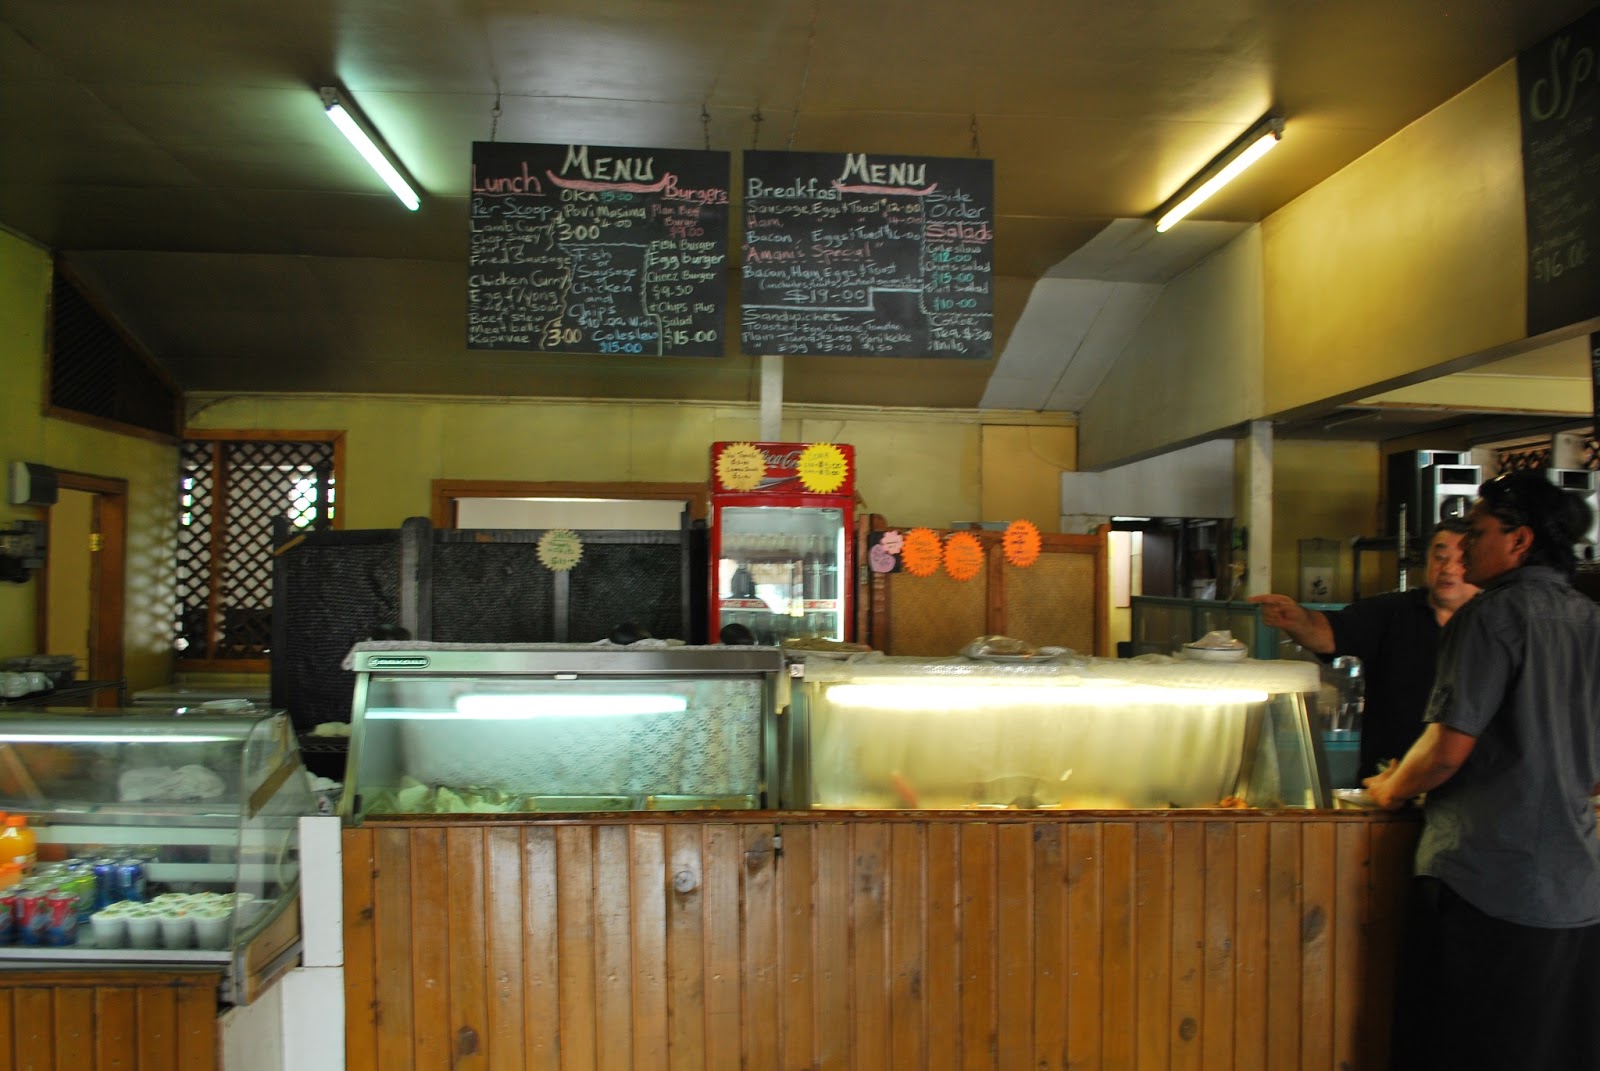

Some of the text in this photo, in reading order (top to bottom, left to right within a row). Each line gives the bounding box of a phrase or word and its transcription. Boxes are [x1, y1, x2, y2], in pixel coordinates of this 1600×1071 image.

[560, 144, 654, 181] MENU
[839, 153, 926, 188] MENU
[472, 161, 542, 193] Lunch
[560, 188, 599, 202] OKA
[664, 175, 728, 206] Burgers
[746, 177, 842, 200] Breakfast
[472, 198, 553, 221] Per Scoop
[930, 202, 986, 219] Order
[471, 219, 555, 236] Lamb Curry
[472, 233, 503, 249] Chop
[681, 239, 718, 254] Burger
[811, 229, 849, 248] Eggs
[513, 252, 572, 270] Sausage
[571, 247, 613, 262] Fish
[648, 252, 680, 270] Egg
[468, 269, 569, 290] Chicken Curry
[577, 264, 638, 283] Sausage
[682, 271, 717, 283] Burger
[571, 281, 632, 294] Chicken
[586, 293, 614, 303] and
[568, 303, 617, 322] Chips
[662, 315, 693, 328] Salad
